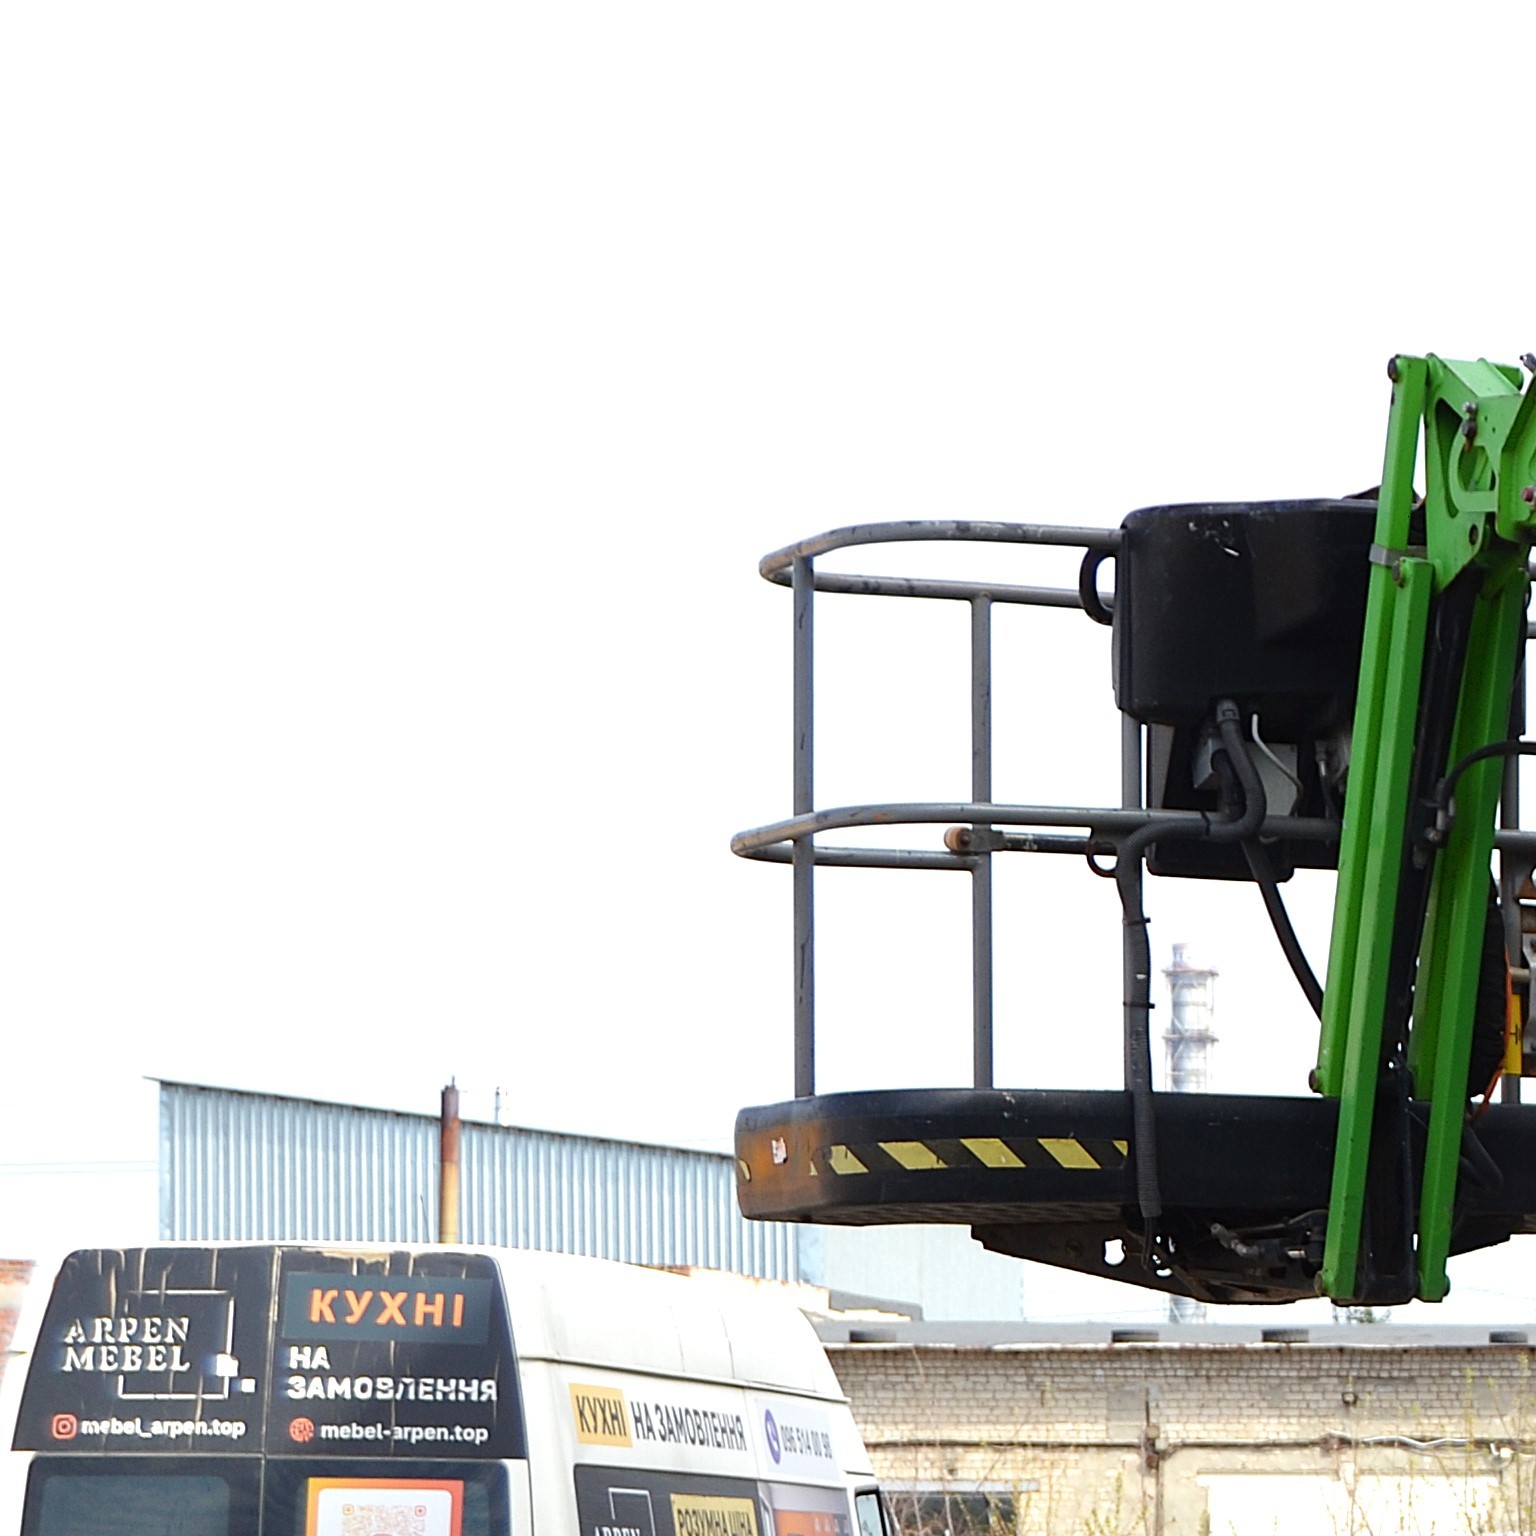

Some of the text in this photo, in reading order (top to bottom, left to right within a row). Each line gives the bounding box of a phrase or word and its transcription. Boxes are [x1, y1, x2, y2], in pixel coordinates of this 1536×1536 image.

[309, 1289, 464, 1327] КУХНІ
[64, 1317, 189, 1344] ARPEN
[61, 1344, 190, 1372] MEBEL
[290, 1347, 330, 1370] НА
[287, 1376, 498, 1401] ЗАМОВЛЕННЯ
[82, 1419, 246, 1438] mebel_arpen.top
[321, 1422, 488, 1443] mebel-arpen.top
[575, 1394, 747, 1451] КУХНІ НА ЗАМОВЛЕННЯ
[796, 1427, 812, 1455] 514
